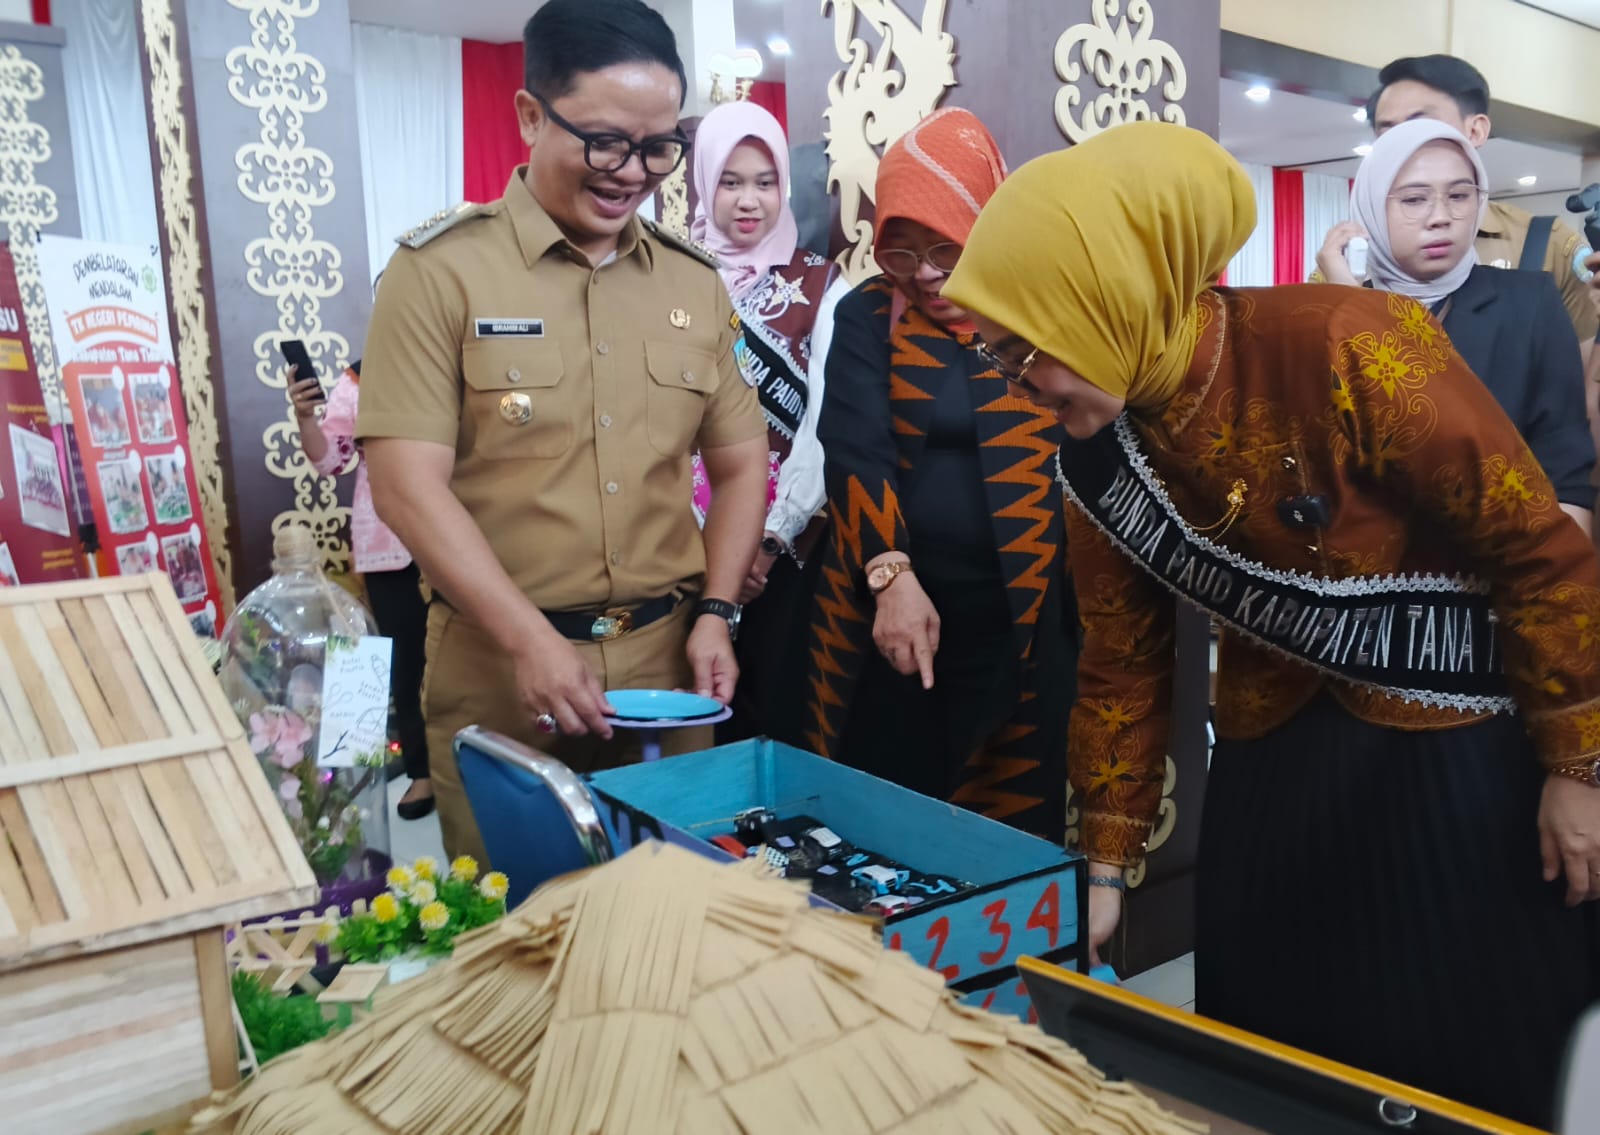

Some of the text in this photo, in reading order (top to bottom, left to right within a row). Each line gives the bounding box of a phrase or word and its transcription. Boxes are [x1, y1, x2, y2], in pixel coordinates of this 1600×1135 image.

[766, 377, 801, 414] PAUD
[1099, 466, 1168, 563] BUNDA
[1165, 539, 1233, 604] PAUD
[1233, 585, 1395, 669] KABUPATEN
[1407, 604, 1474, 673] TANA
[926, 881, 1060, 981] 2 3 4
